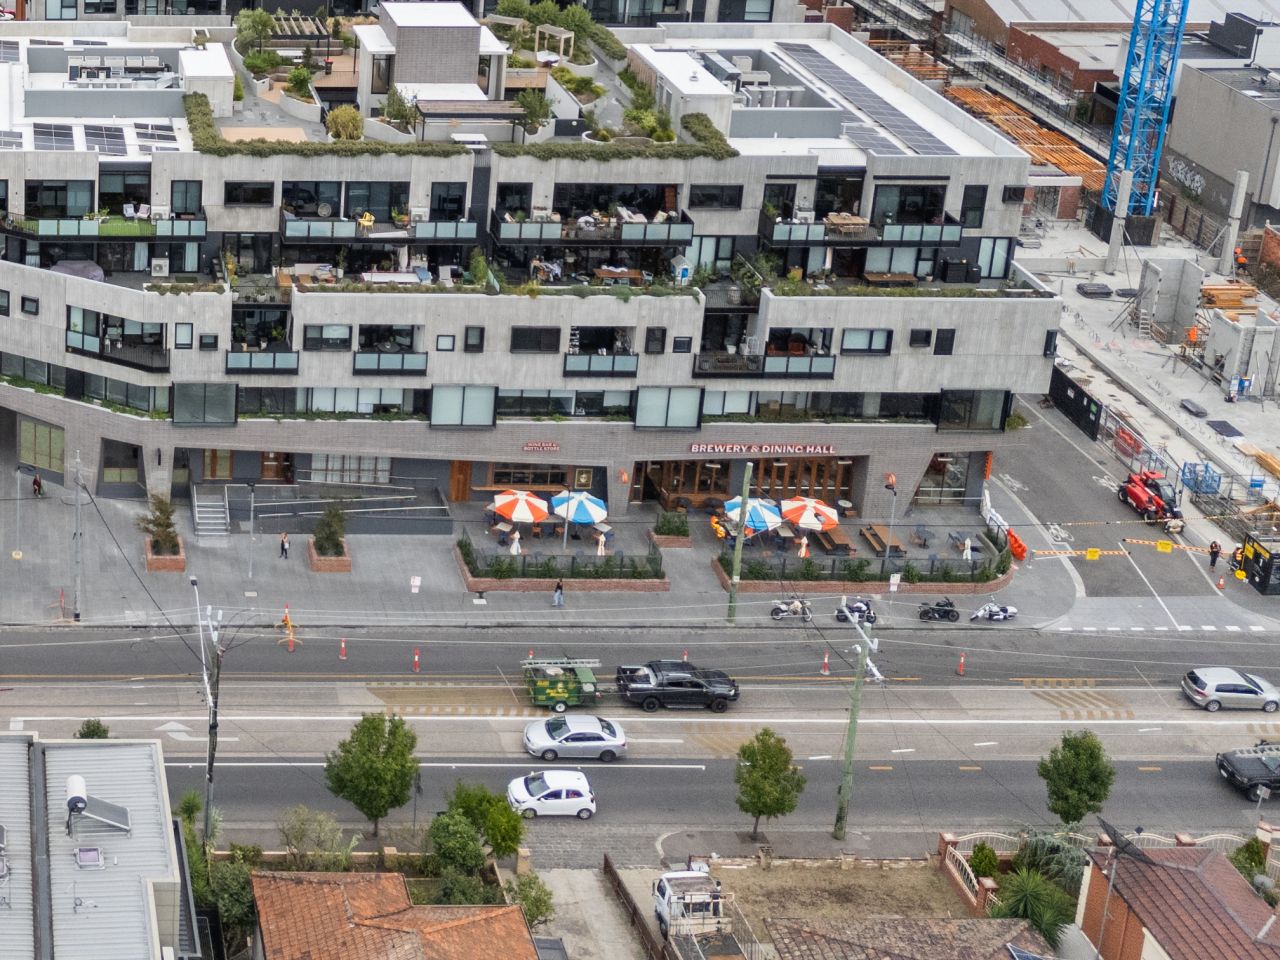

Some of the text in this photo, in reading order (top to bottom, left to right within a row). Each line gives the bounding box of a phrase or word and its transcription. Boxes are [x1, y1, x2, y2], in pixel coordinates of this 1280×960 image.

[691, 444, 836, 454] BREWERY & DINING HALL
